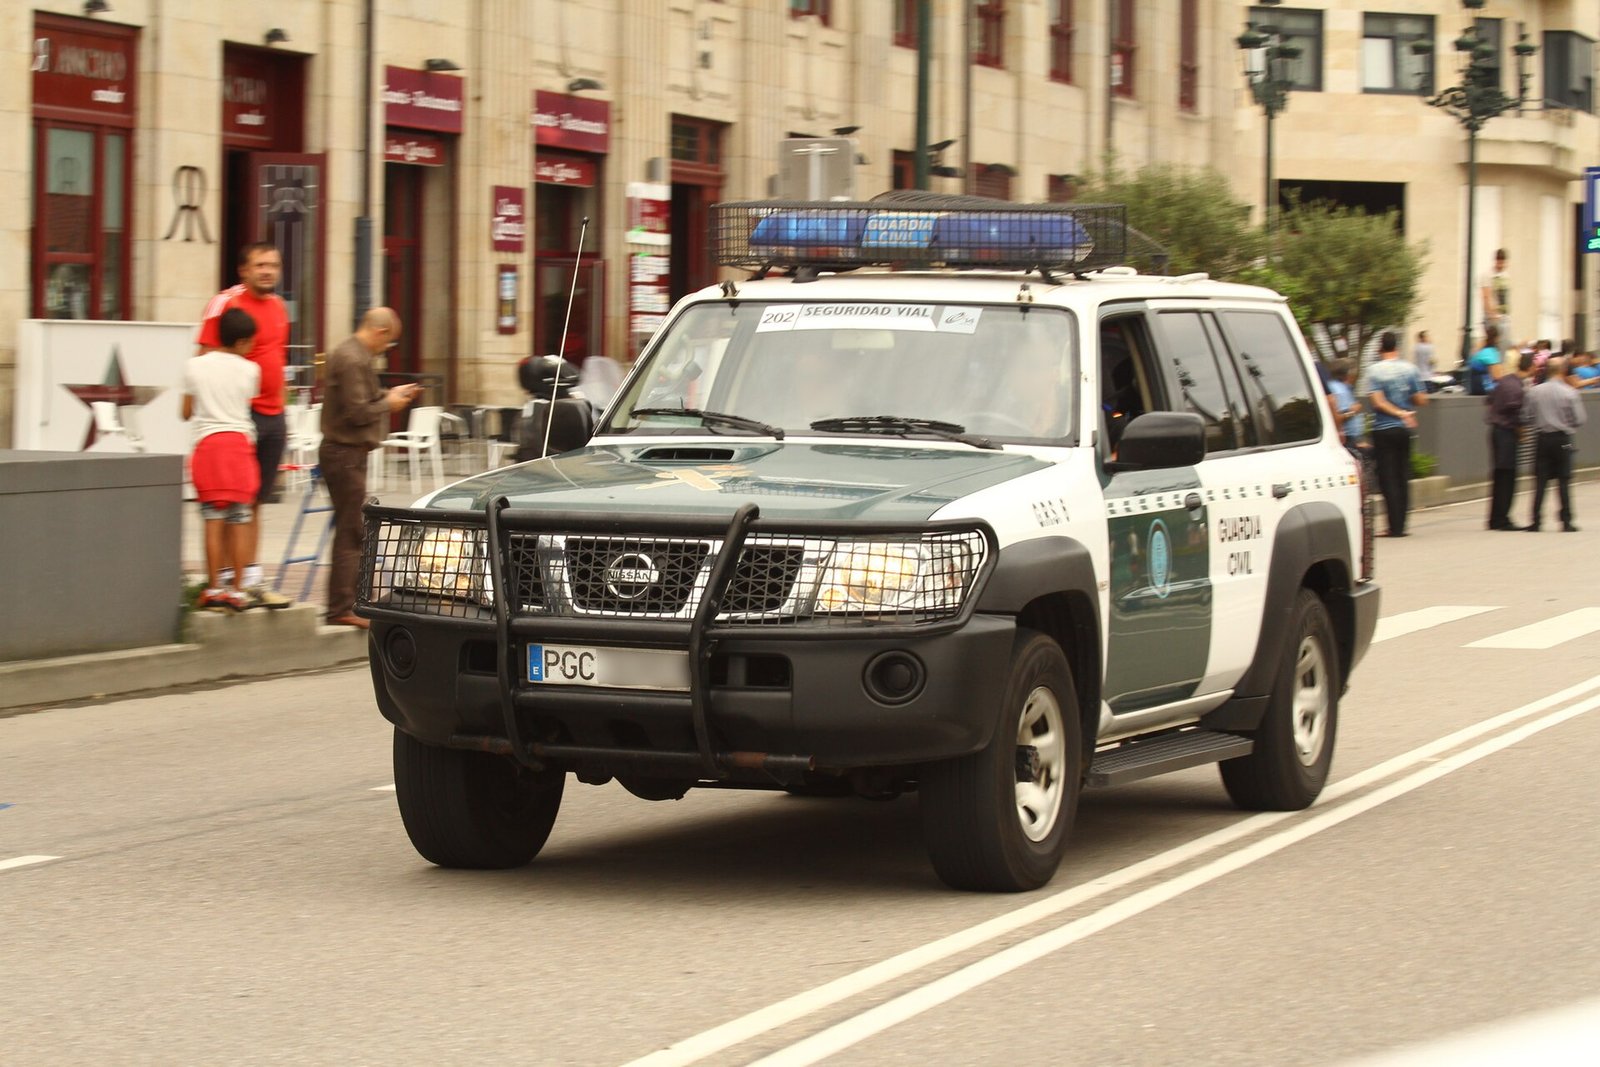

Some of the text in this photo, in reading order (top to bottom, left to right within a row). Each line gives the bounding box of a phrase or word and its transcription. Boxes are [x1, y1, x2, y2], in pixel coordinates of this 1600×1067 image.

[868, 219, 933, 230] GUARDIA
[878, 231, 914, 243] CIVIL
[803, 305, 930, 318] SEGURIDAD VIAL
[762, 312, 795, 325] 202
[1218, 514, 1263, 542] GUARDIA
[1227, 551, 1253, 575] CIVIL
[607, 571, 650, 580] NISSAN
[533, 666, 539, 675] E
[545, 649, 595, 680] PGC
